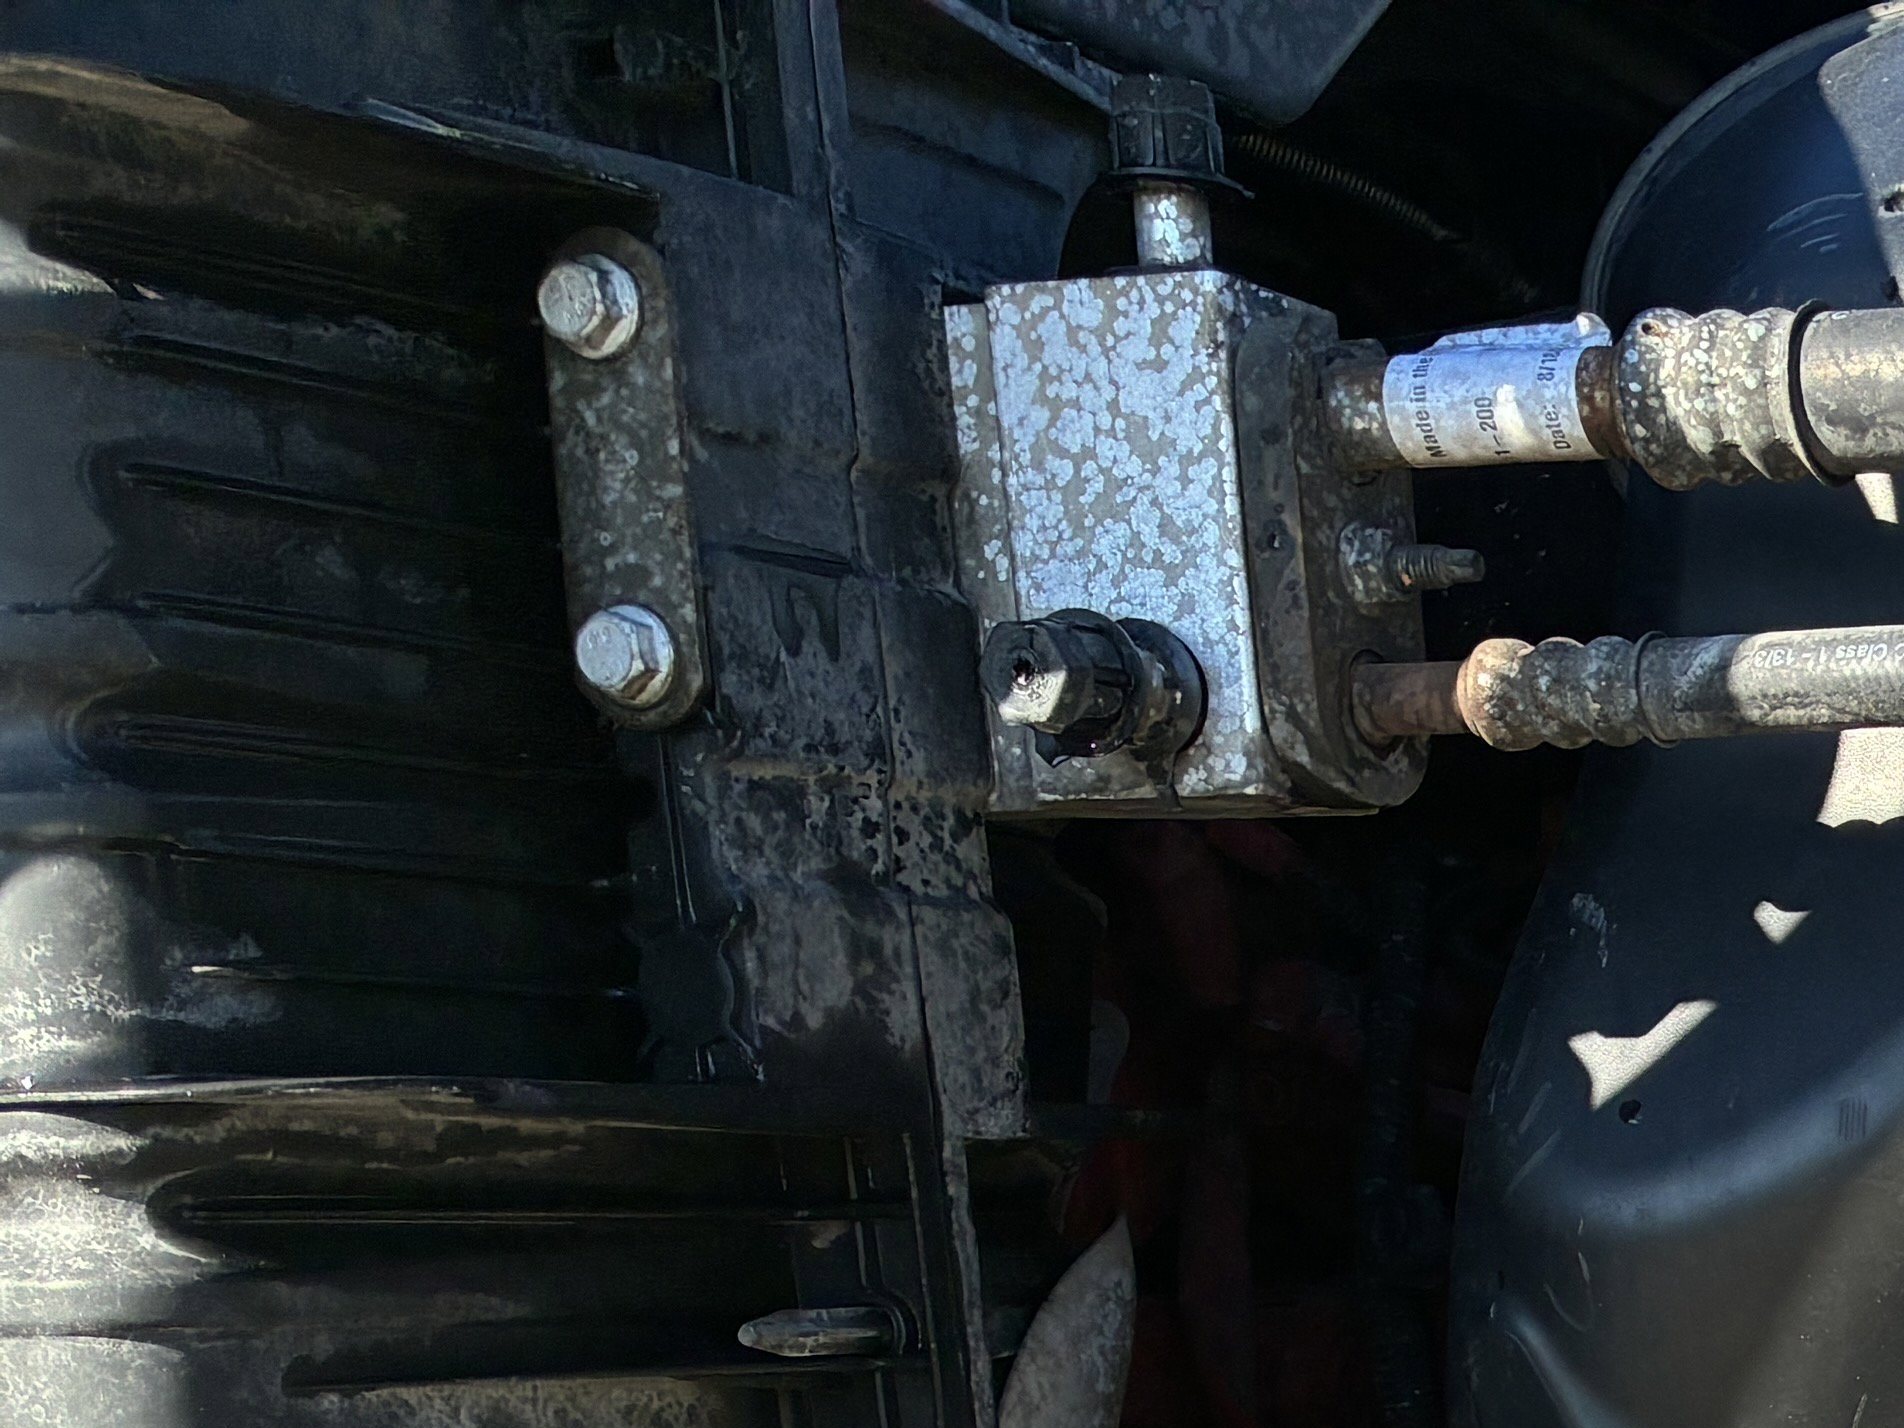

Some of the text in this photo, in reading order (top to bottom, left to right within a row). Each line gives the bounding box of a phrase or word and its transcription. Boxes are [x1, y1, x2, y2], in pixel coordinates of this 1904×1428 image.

[1409, 384, 1426, 404] in
[1414, 405, 1448, 459] Made
[1544, 403, 1572, 450] Date:
[1834, 641, 1892, 663] Class
